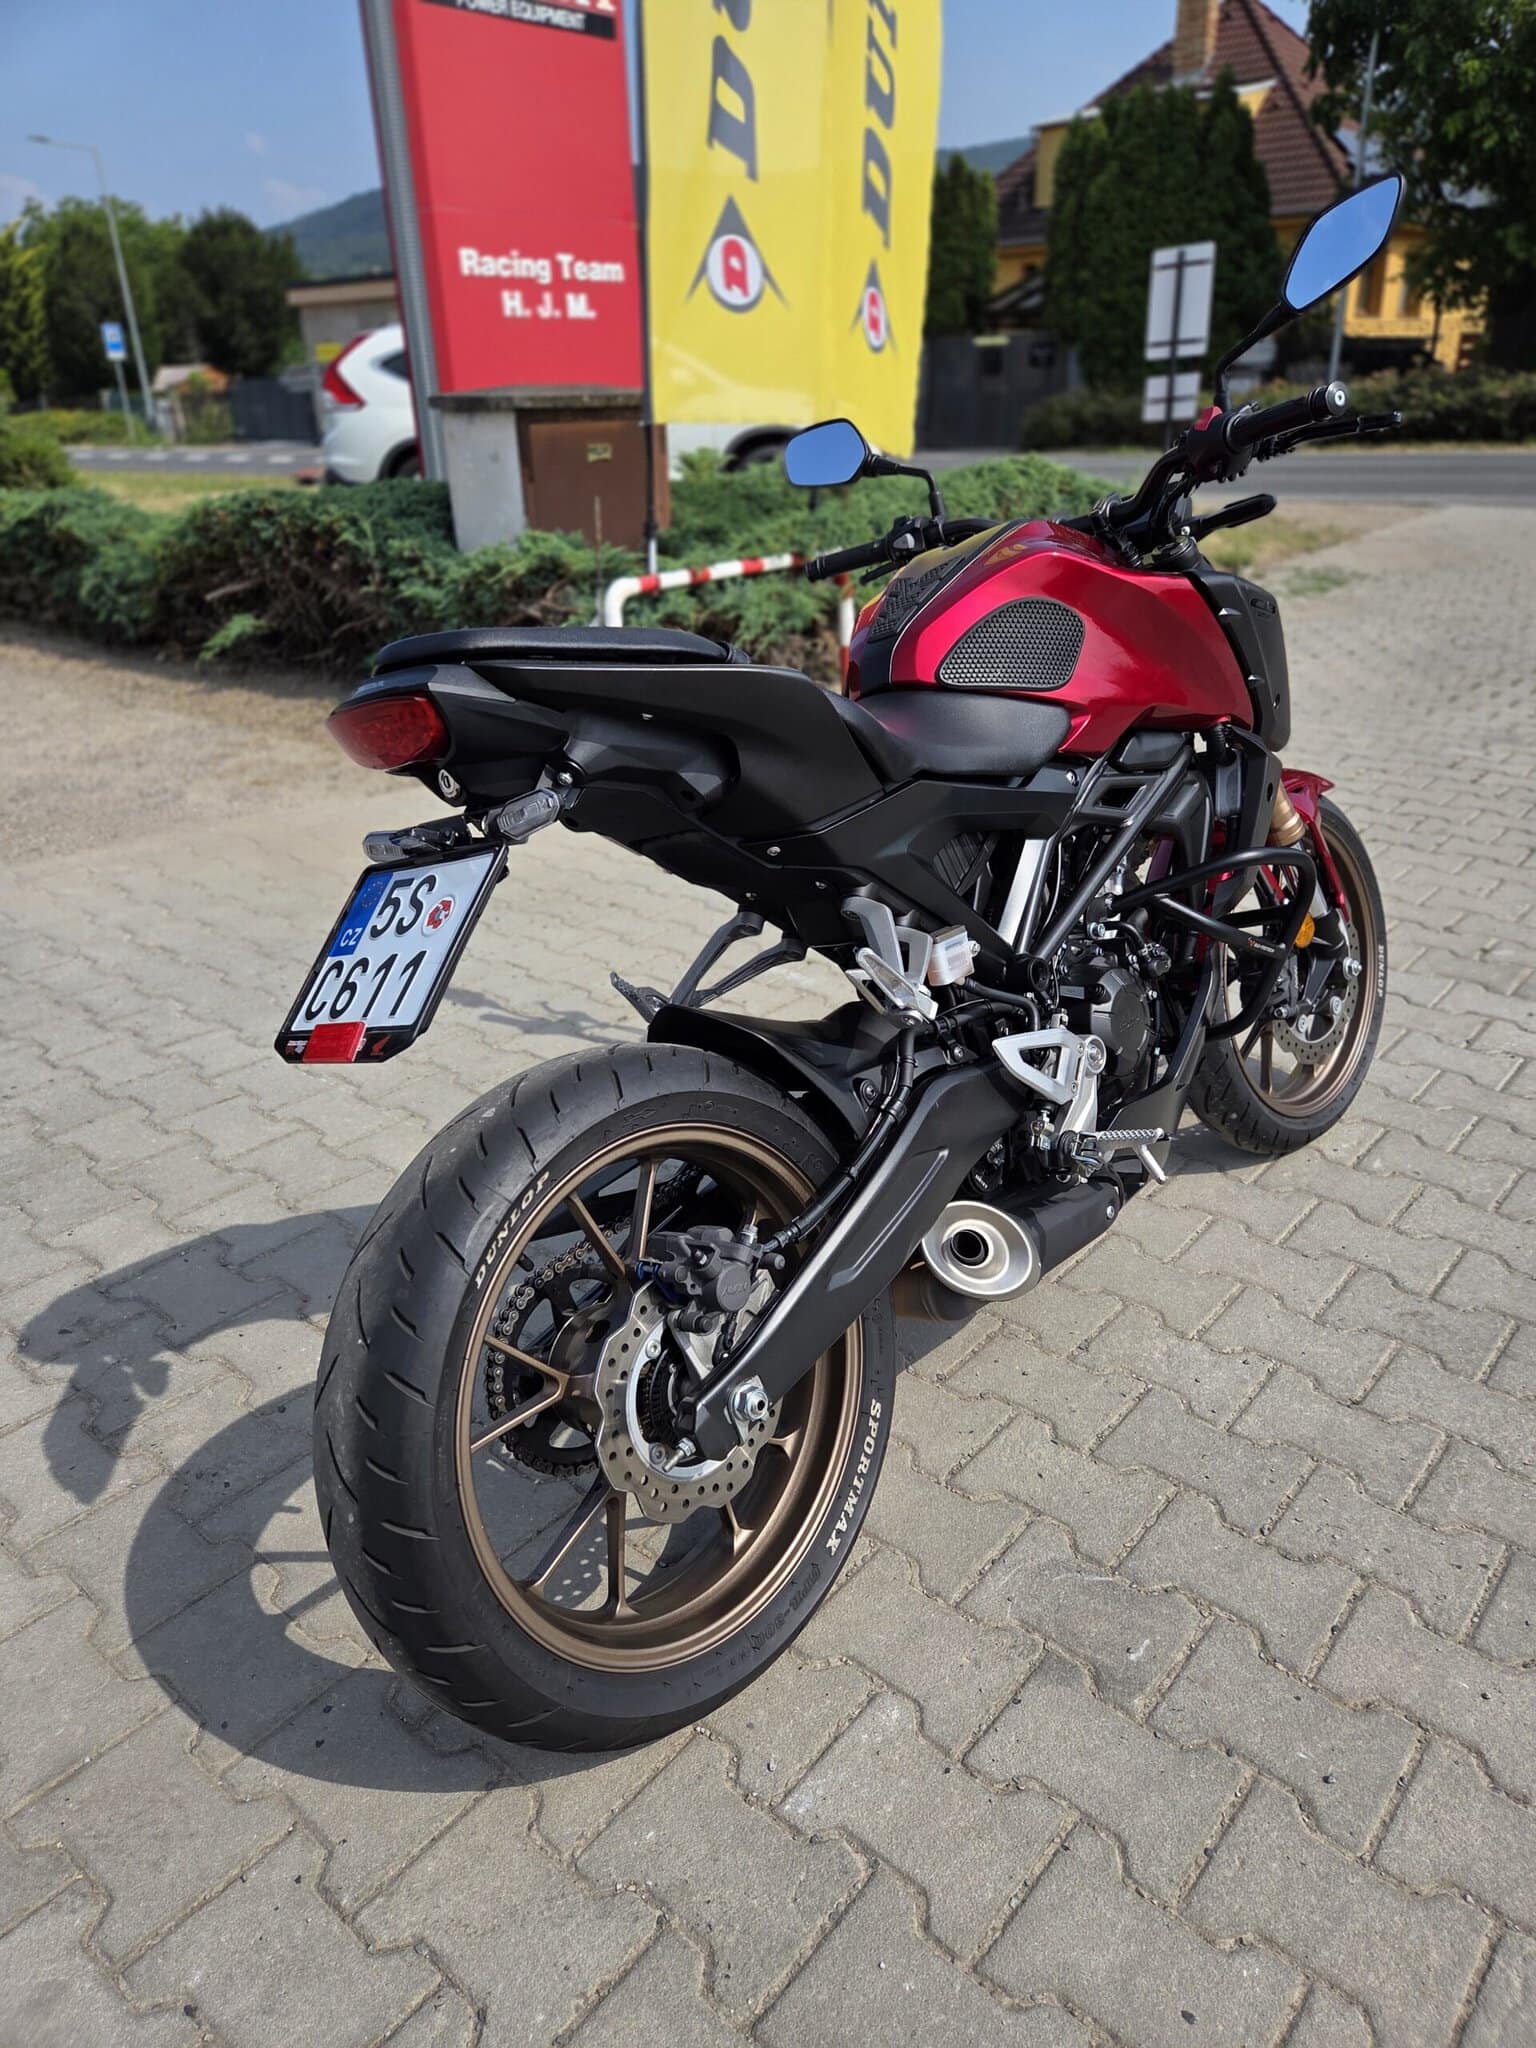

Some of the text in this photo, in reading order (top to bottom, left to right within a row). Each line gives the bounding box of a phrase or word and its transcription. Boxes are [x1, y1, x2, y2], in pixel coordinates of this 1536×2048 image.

[511, 1, 586, 31] EQUIPMENT
[707, 0, 758, 184] D
[458, 248, 625, 284] Racing Team
[501, 290, 596, 320] H. J. M.
[369, 874, 437, 939] 5S
[339, 926, 363, 948] CZ
[304, 950, 428, 1021] C611
[1377, 944, 1385, 998] DUNLOP
[474, 1171, 551, 1291] DUNLOP
[825, 1398, 882, 1556] SPORTMAX
